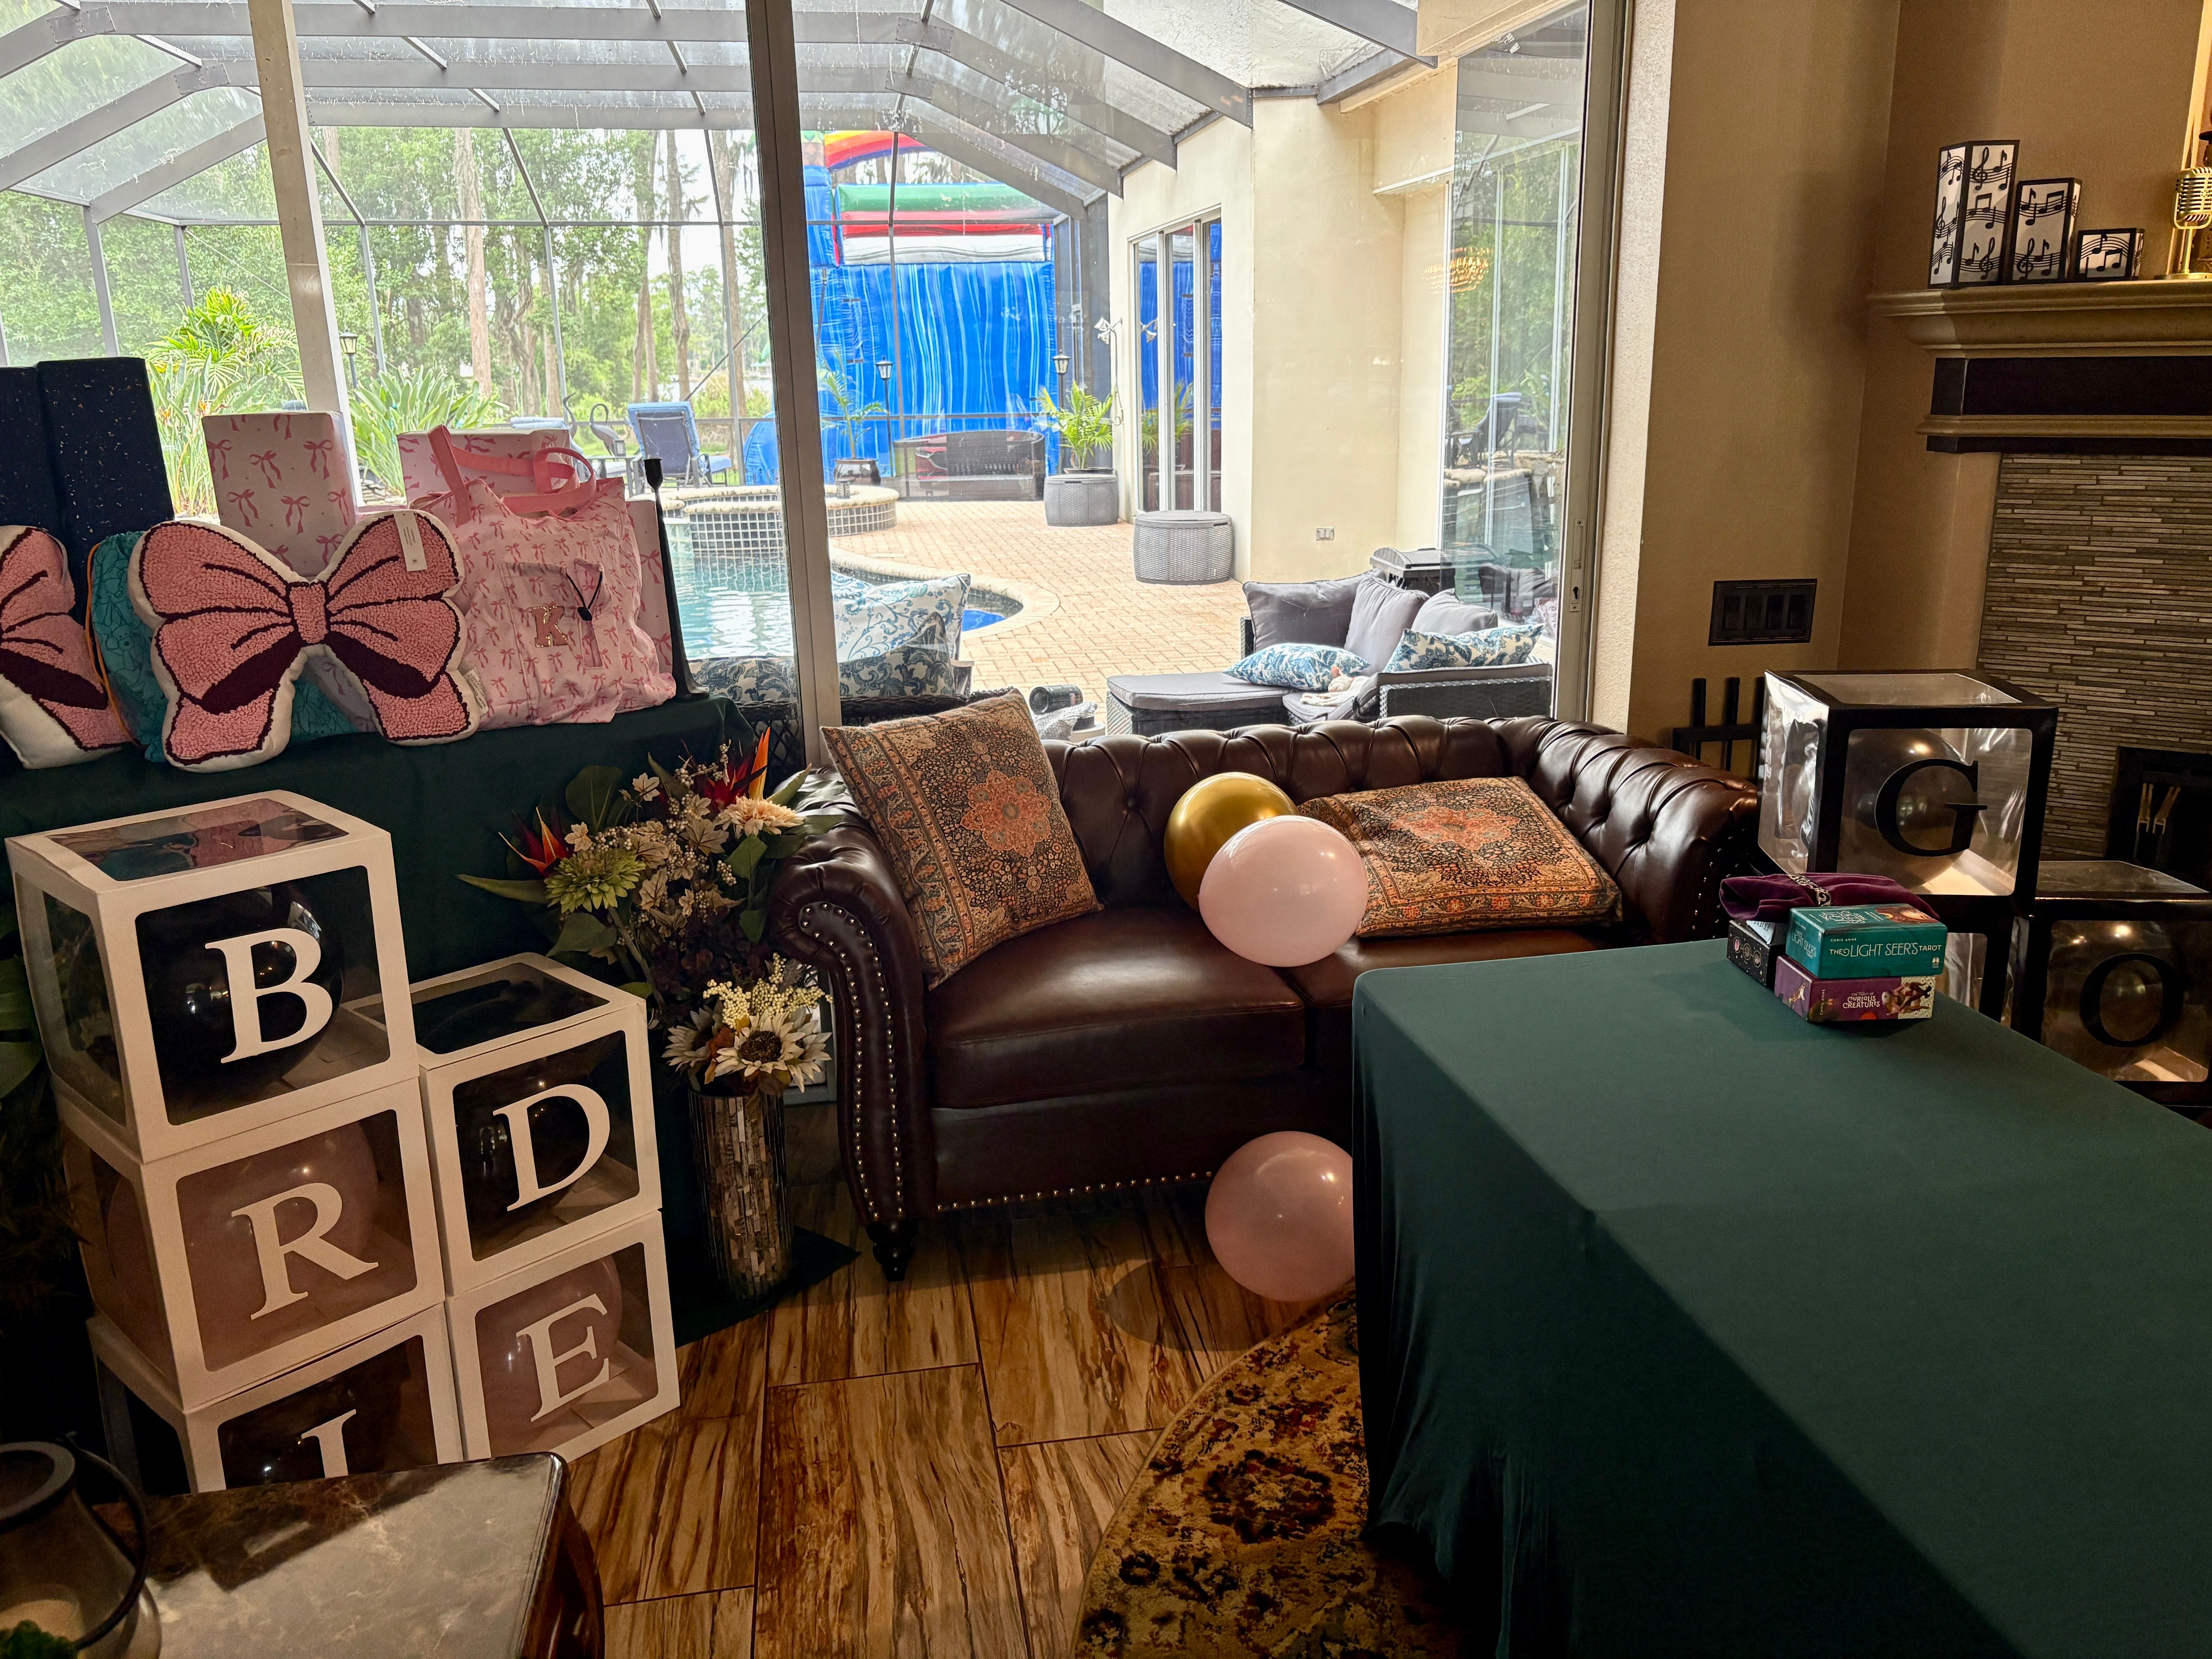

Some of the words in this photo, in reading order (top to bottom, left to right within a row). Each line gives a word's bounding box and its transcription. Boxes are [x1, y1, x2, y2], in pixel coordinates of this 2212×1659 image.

[531, 606, 568, 647] K
[1875, 758, 1988, 857] G
[204, 927, 333, 1064] B
[1829, 948, 1850, 957] THE
[1850, 943, 1884, 957] LIGHT
[1885, 942, 1918, 956] SEER'S
[2080, 953, 2184, 1048] O
[493, 1084, 610, 1212] D
[231, 1182, 379, 1320] R
[516, 1293, 609, 1422] E
